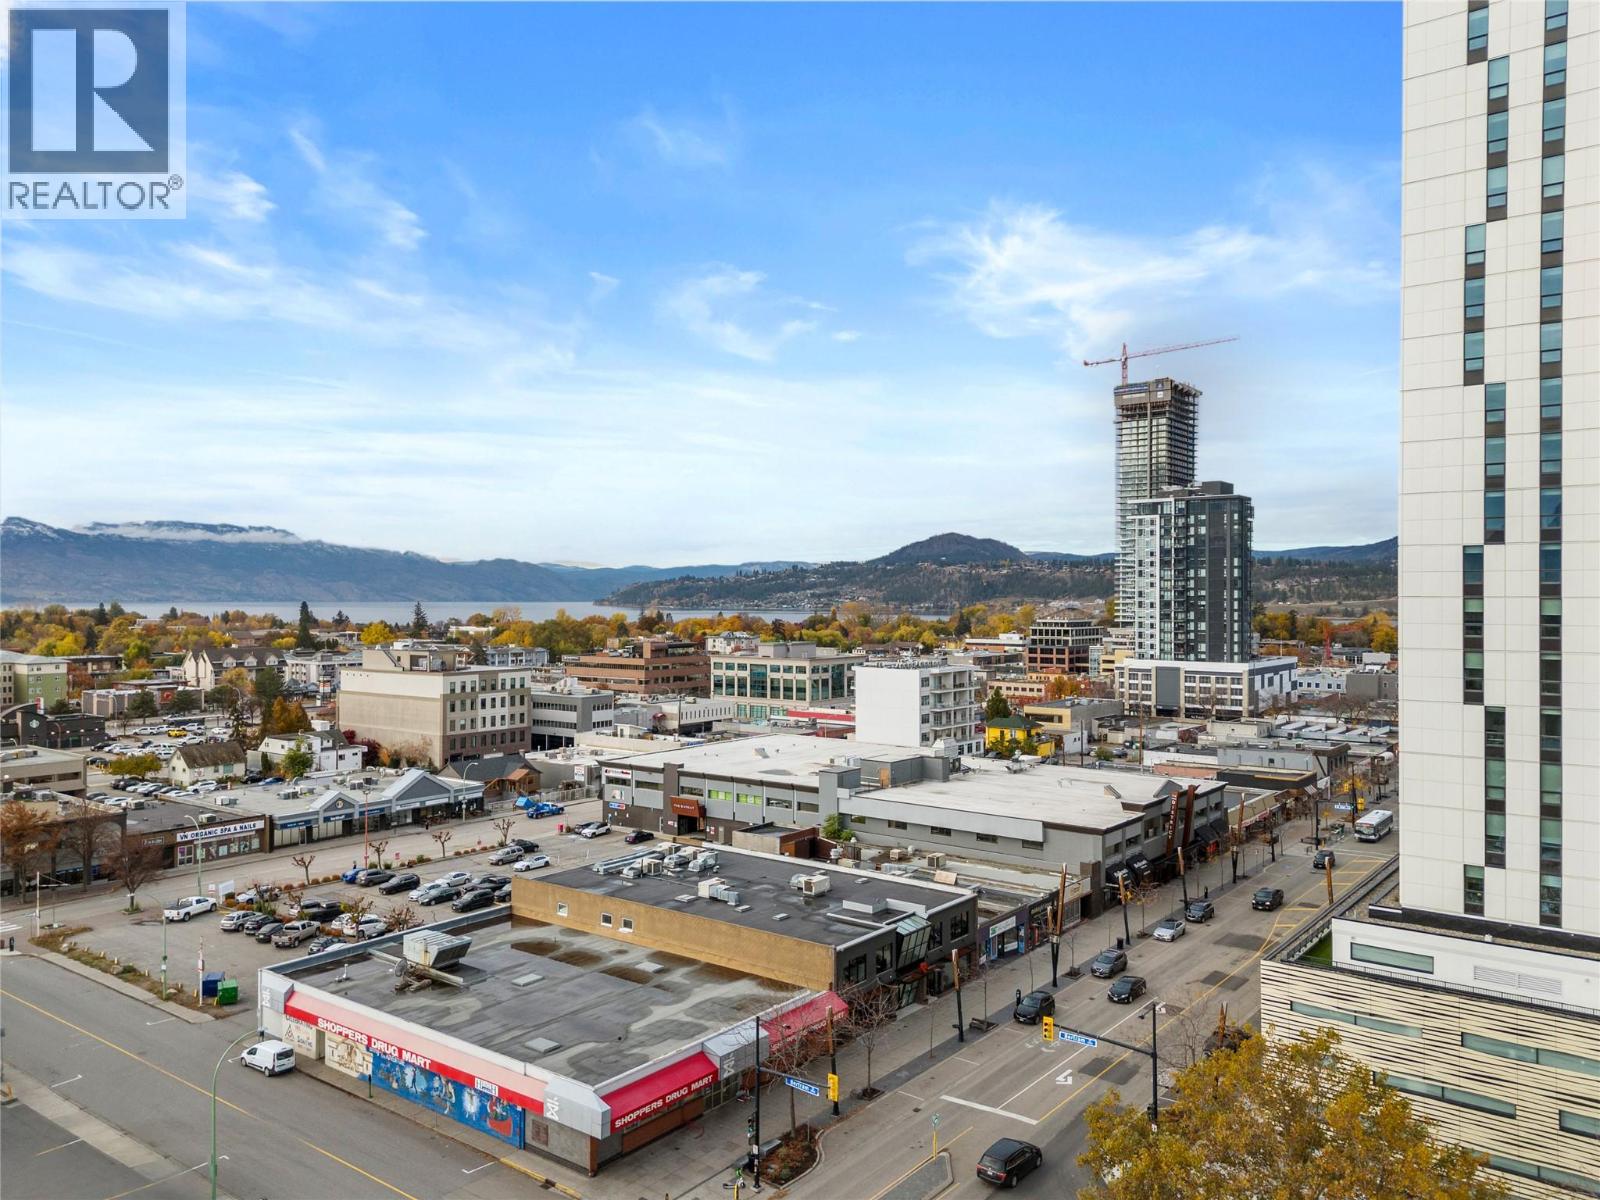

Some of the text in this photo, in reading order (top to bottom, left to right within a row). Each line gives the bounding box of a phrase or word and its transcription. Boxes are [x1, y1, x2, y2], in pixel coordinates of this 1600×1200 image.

[190, 829, 218, 839] ORGANIC
[219, 825, 231, 834] SPA
[233, 824, 238, 832] &
[239, 823, 257, 831] NAILS
[317, 1017, 368, 1045] SHOPPERS
[371, 1038, 398, 1057] DRUG
[402, 1049, 431, 1070] MART
[614, 1075, 713, 1128] SHOPPERS DRUG MART
